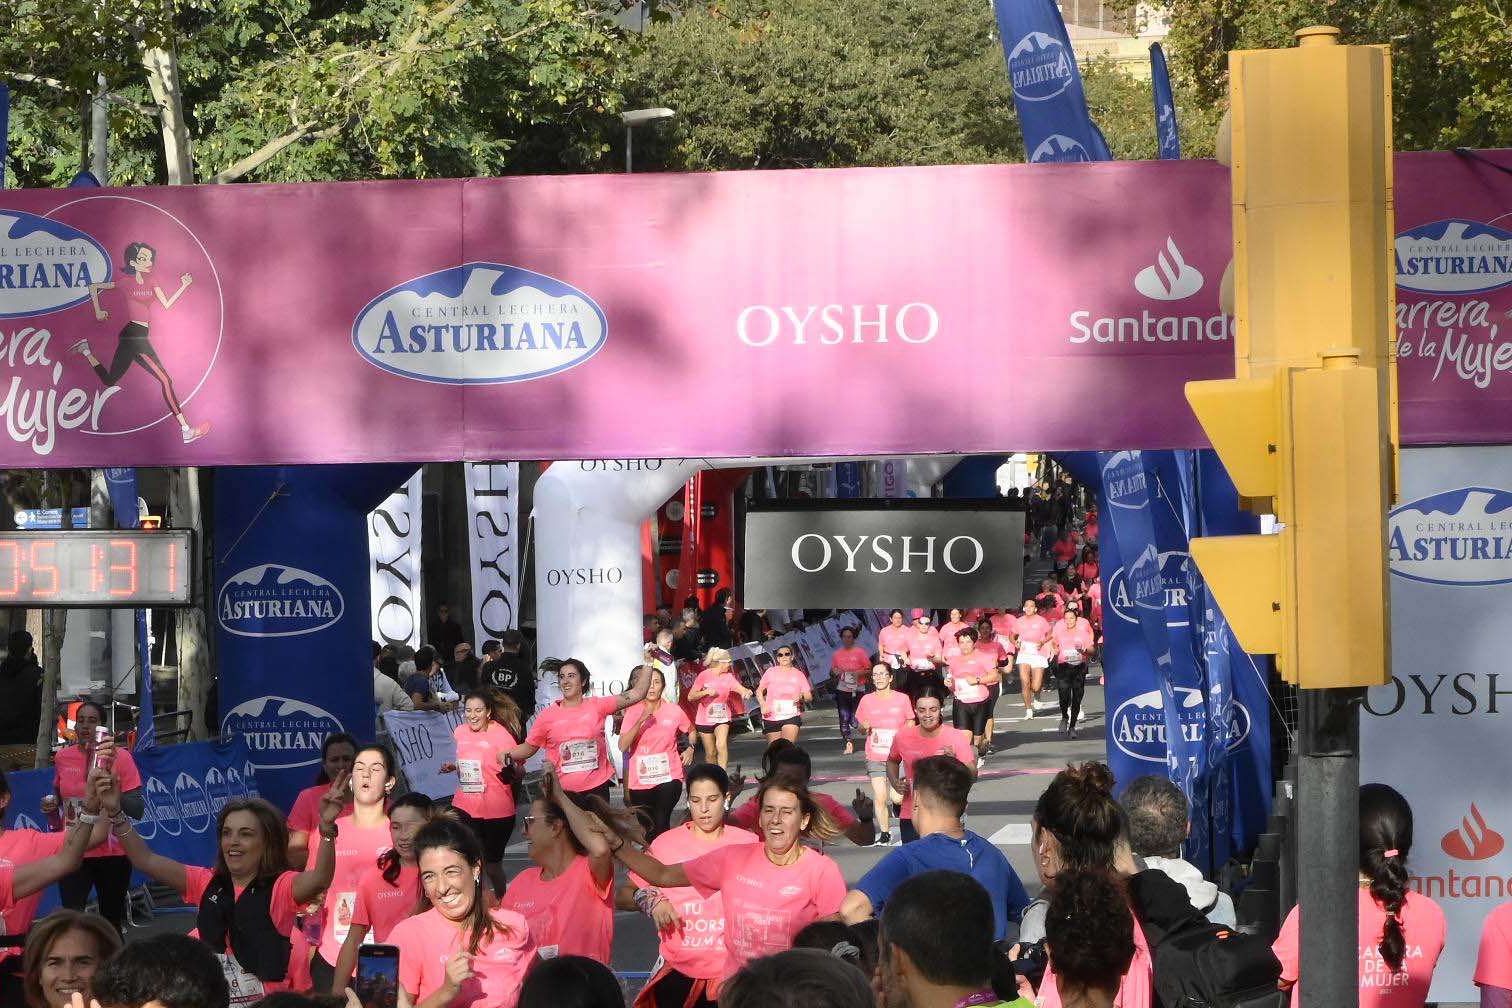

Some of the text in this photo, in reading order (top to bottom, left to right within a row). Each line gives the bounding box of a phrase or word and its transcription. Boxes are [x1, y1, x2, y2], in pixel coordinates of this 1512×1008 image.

[14, 245, 88, 257] LECHERA
[1464, 244, 1512, 252] LECHER
[411, 303, 580, 318] CENTRAL LECHERA
[1396, 300, 1489, 329] arrera
[372, 309, 587, 355] ASTURIANA
[737, 302, 940, 346] OYSHO
[1069, 310, 1236, 345] Santand
[1419, 331, 1436, 358] la
[1432, 326, 1512, 389] Muje
[1415, 521, 1483, 532] CENTRAL
[790, 533, 984, 575] OYSHO
[547, 566, 623, 587] OYSHO
[234, 589, 330, 598] CENTRAL LECHERA
[221, 595, 335, 621] ASTURIANA
[497, 672, 512, 683] BP
[1361, 673, 1512, 716] OYSH
[683, 902, 703, 916] TU
[684, 918, 726, 933] DORS
[1364, 959, 1385, 974] DE
[1361, 972, 1409, 988] MUJER
